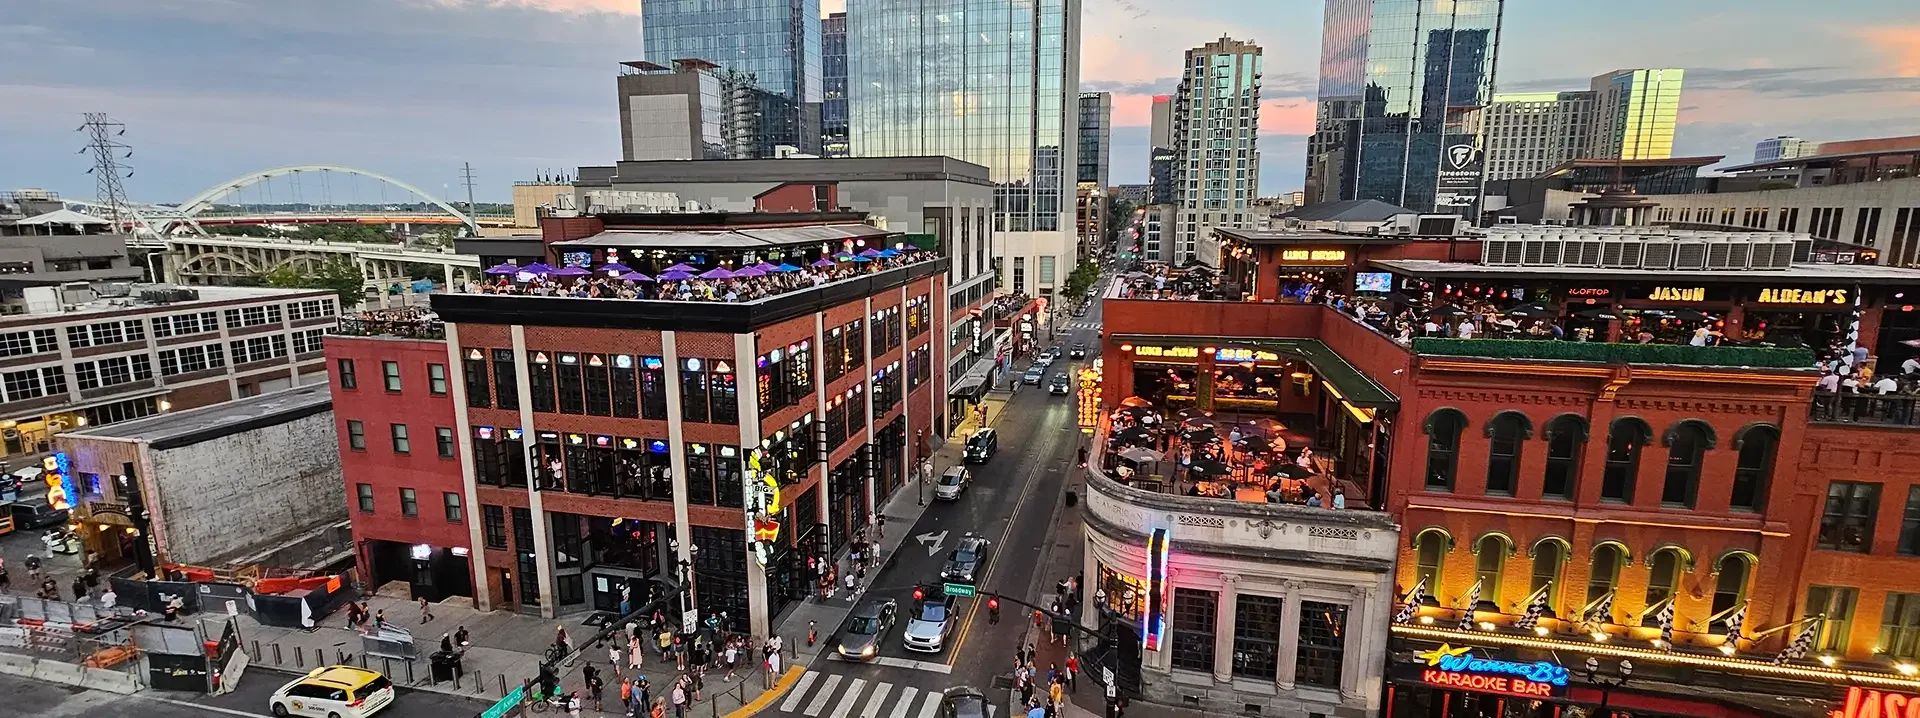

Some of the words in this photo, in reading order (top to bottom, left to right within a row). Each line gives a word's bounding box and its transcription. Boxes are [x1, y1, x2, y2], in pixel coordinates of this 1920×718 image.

[1282, 250, 1309, 260] LUKE
[1758, 288, 1848, 304] ALDEAN'S
[754, 485, 769, 493] BIG
[945, 585, 972, 596] Broadway
[1424, 670, 1507, 692] KARAOKE
[1512, 679, 1551, 697] BAR
